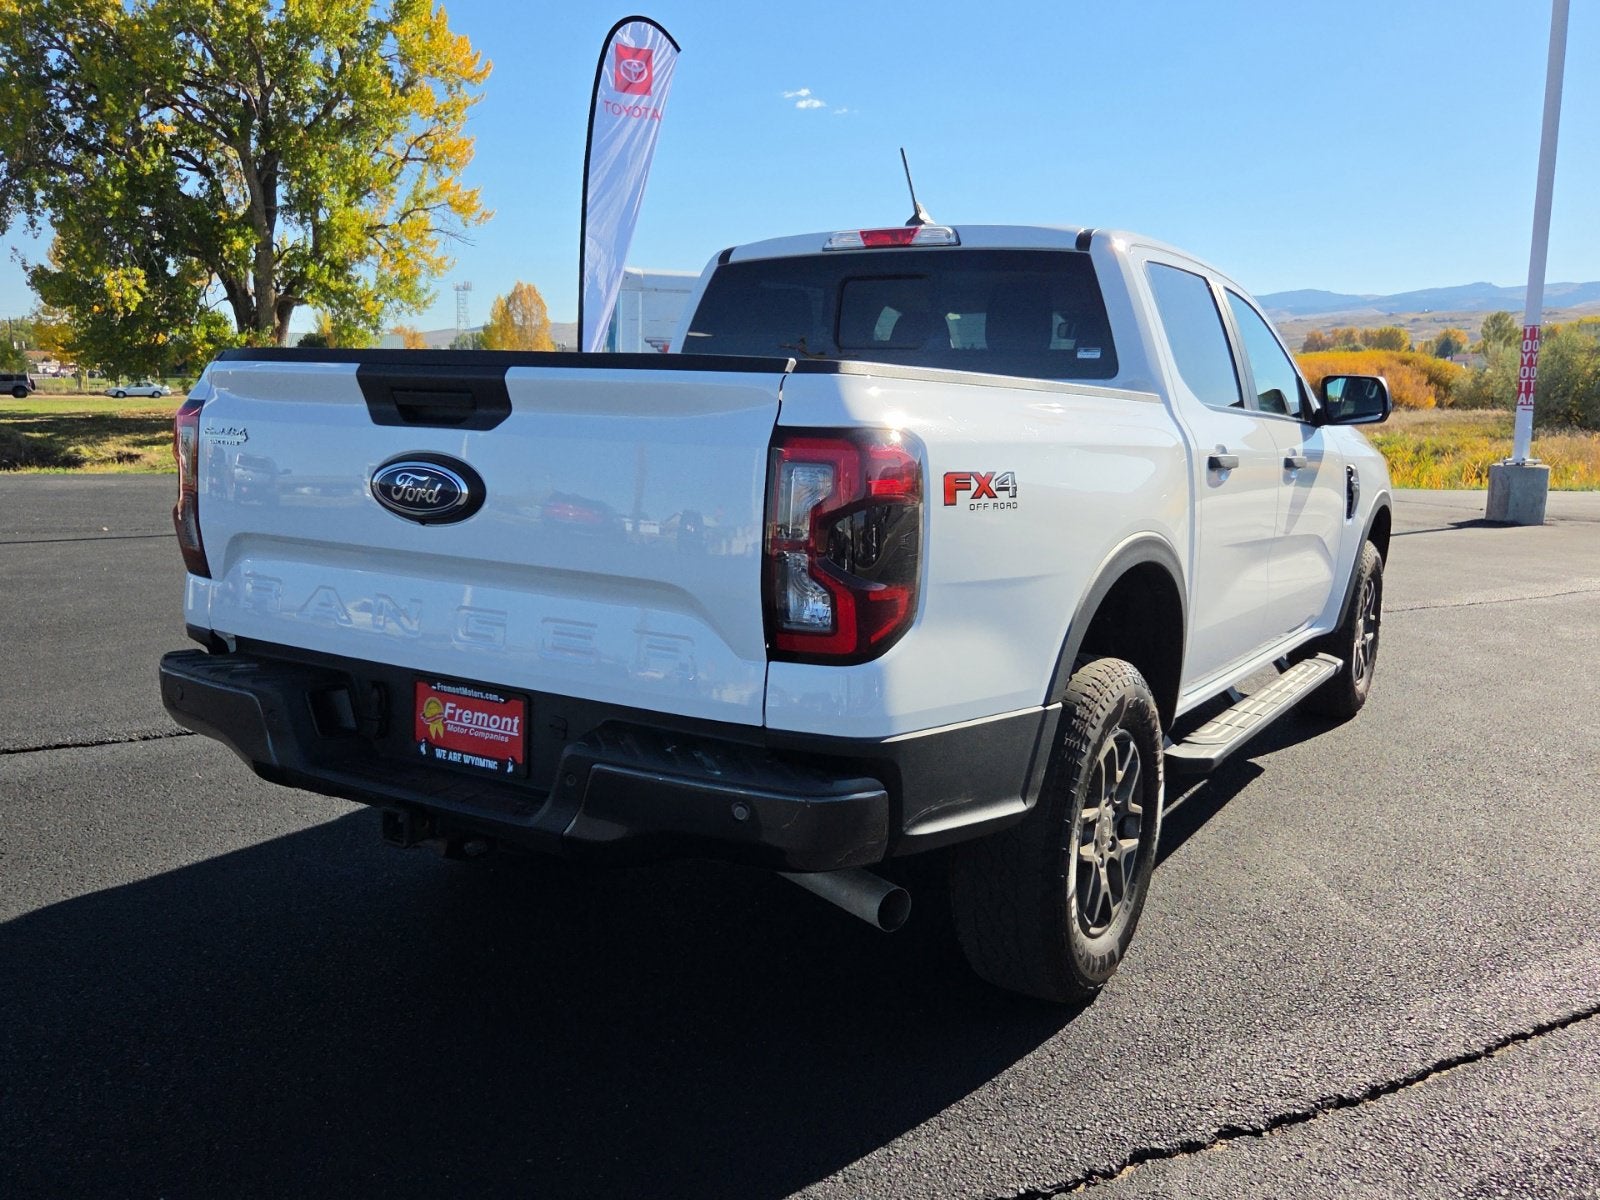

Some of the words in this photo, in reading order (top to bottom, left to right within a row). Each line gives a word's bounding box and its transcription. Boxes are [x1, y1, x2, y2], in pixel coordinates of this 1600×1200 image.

[603, 100, 661, 121] TOYOTA
[1518, 325, 1533, 405] TOYOTA
[391, 472, 442, 504] Ford
[943, 471, 1018, 506] FX4
[969, 502, 990, 511] OFF
[992, 501, 1018, 510] ROAD
[243, 571, 698, 682] RANGER
[444, 702, 520, 733] Fremont
[446, 724, 467, 735] Motor
[469, 727, 509, 743] Companies
[435, 748, 447, 759] WE
[448, 751, 462, 763] ARE
